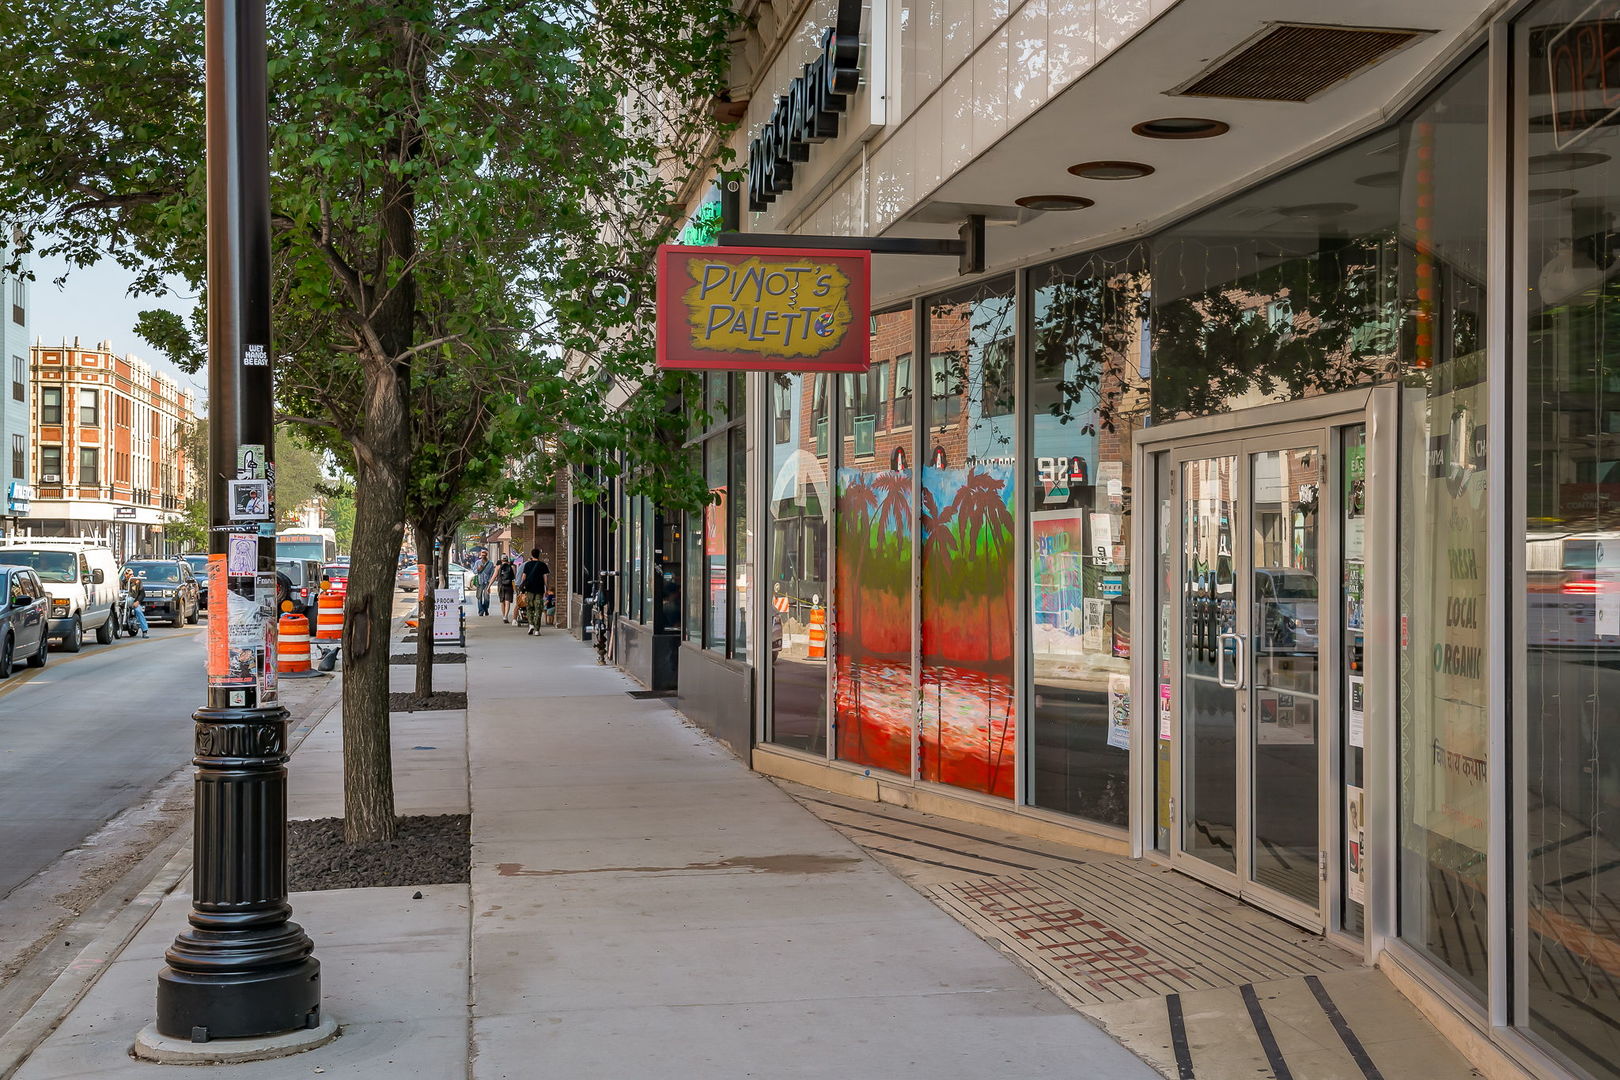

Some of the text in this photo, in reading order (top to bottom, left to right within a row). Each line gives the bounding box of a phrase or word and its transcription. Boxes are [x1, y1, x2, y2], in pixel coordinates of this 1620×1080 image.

[700, 263, 832, 309] PINOT'S
[705, 301, 838, 346] PALETTE
[245, 351, 267, 359] HANDS
[1475, 439, 1487, 458] CH
[1446, 596, 1477, 630] LOCAL
[1433, 642, 1482, 680] ORGANIC
